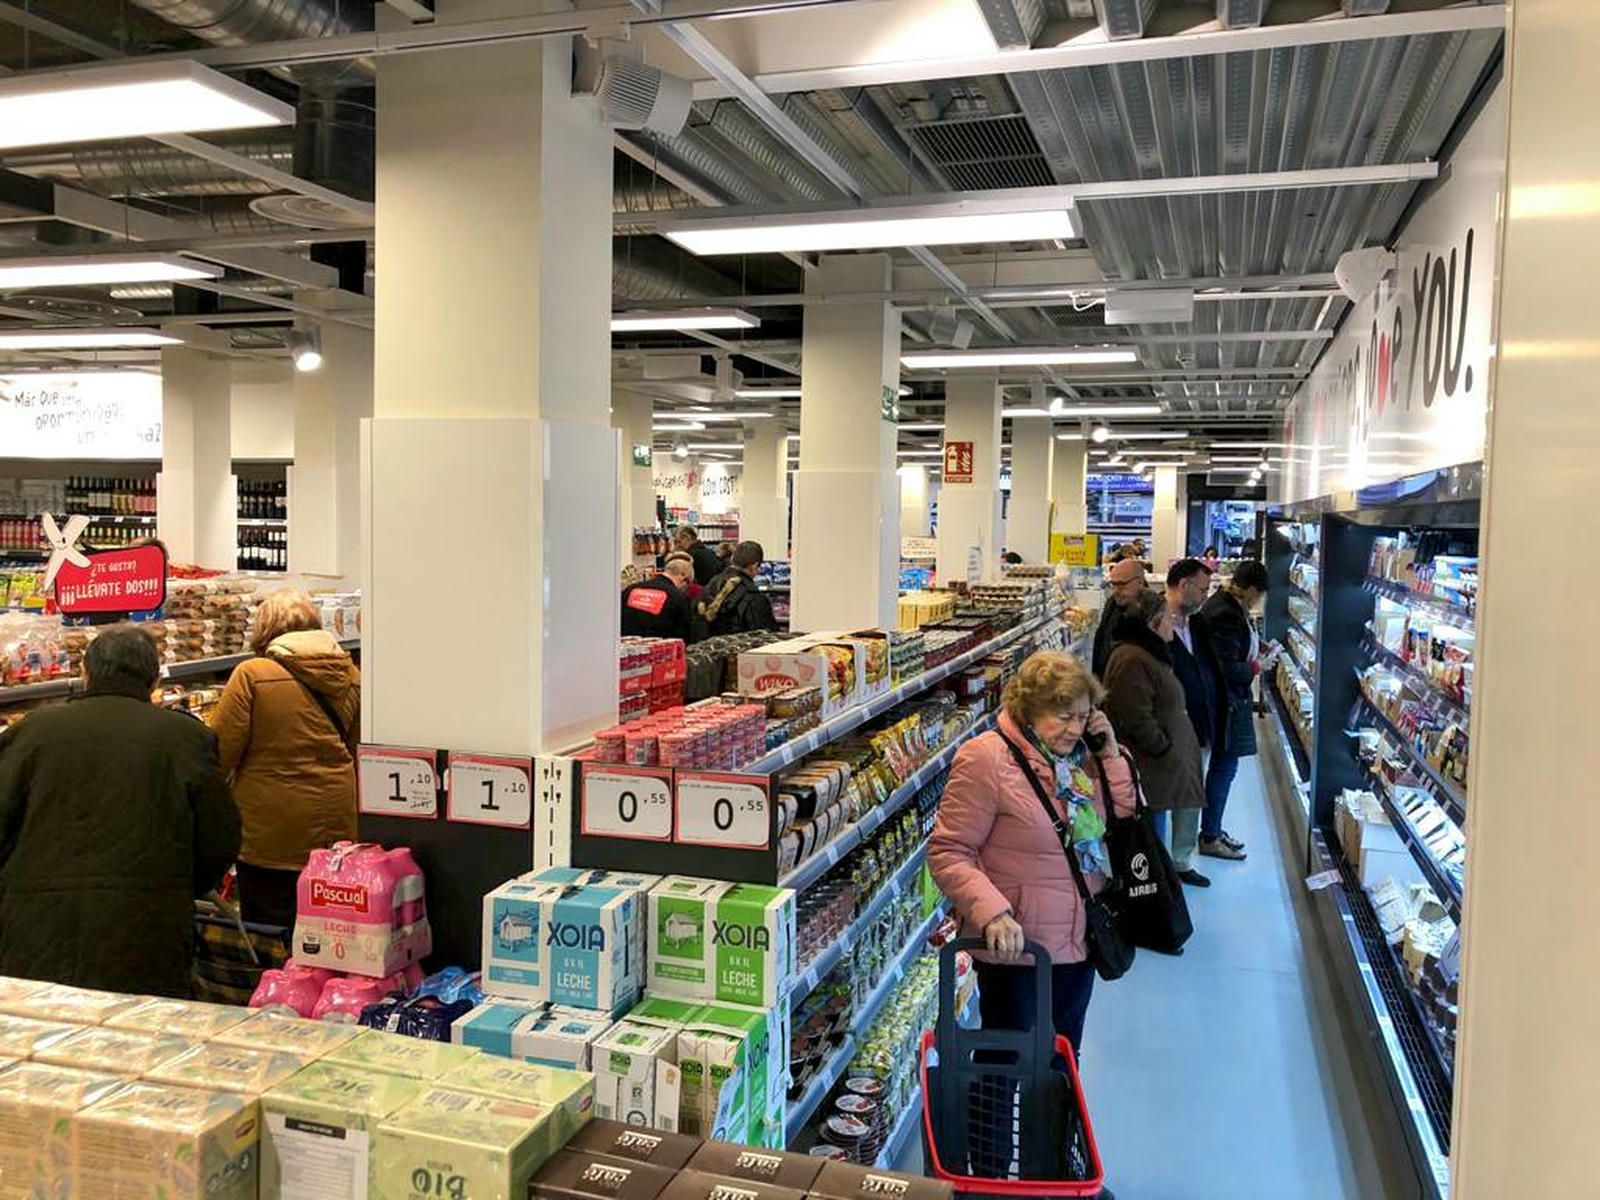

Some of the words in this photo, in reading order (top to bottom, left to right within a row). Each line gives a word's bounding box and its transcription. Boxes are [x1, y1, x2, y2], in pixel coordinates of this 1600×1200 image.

[1407, 227, 1473, 412] YOU!
[314, 882, 365, 906] Pascual
[324, 921, 358, 935] LECHE
[546, 920, 606, 953] XOIA
[711, 919, 770, 953] XOIA
[556, 971, 593, 991] LECHE
[722, 969, 758, 989] LECHE
